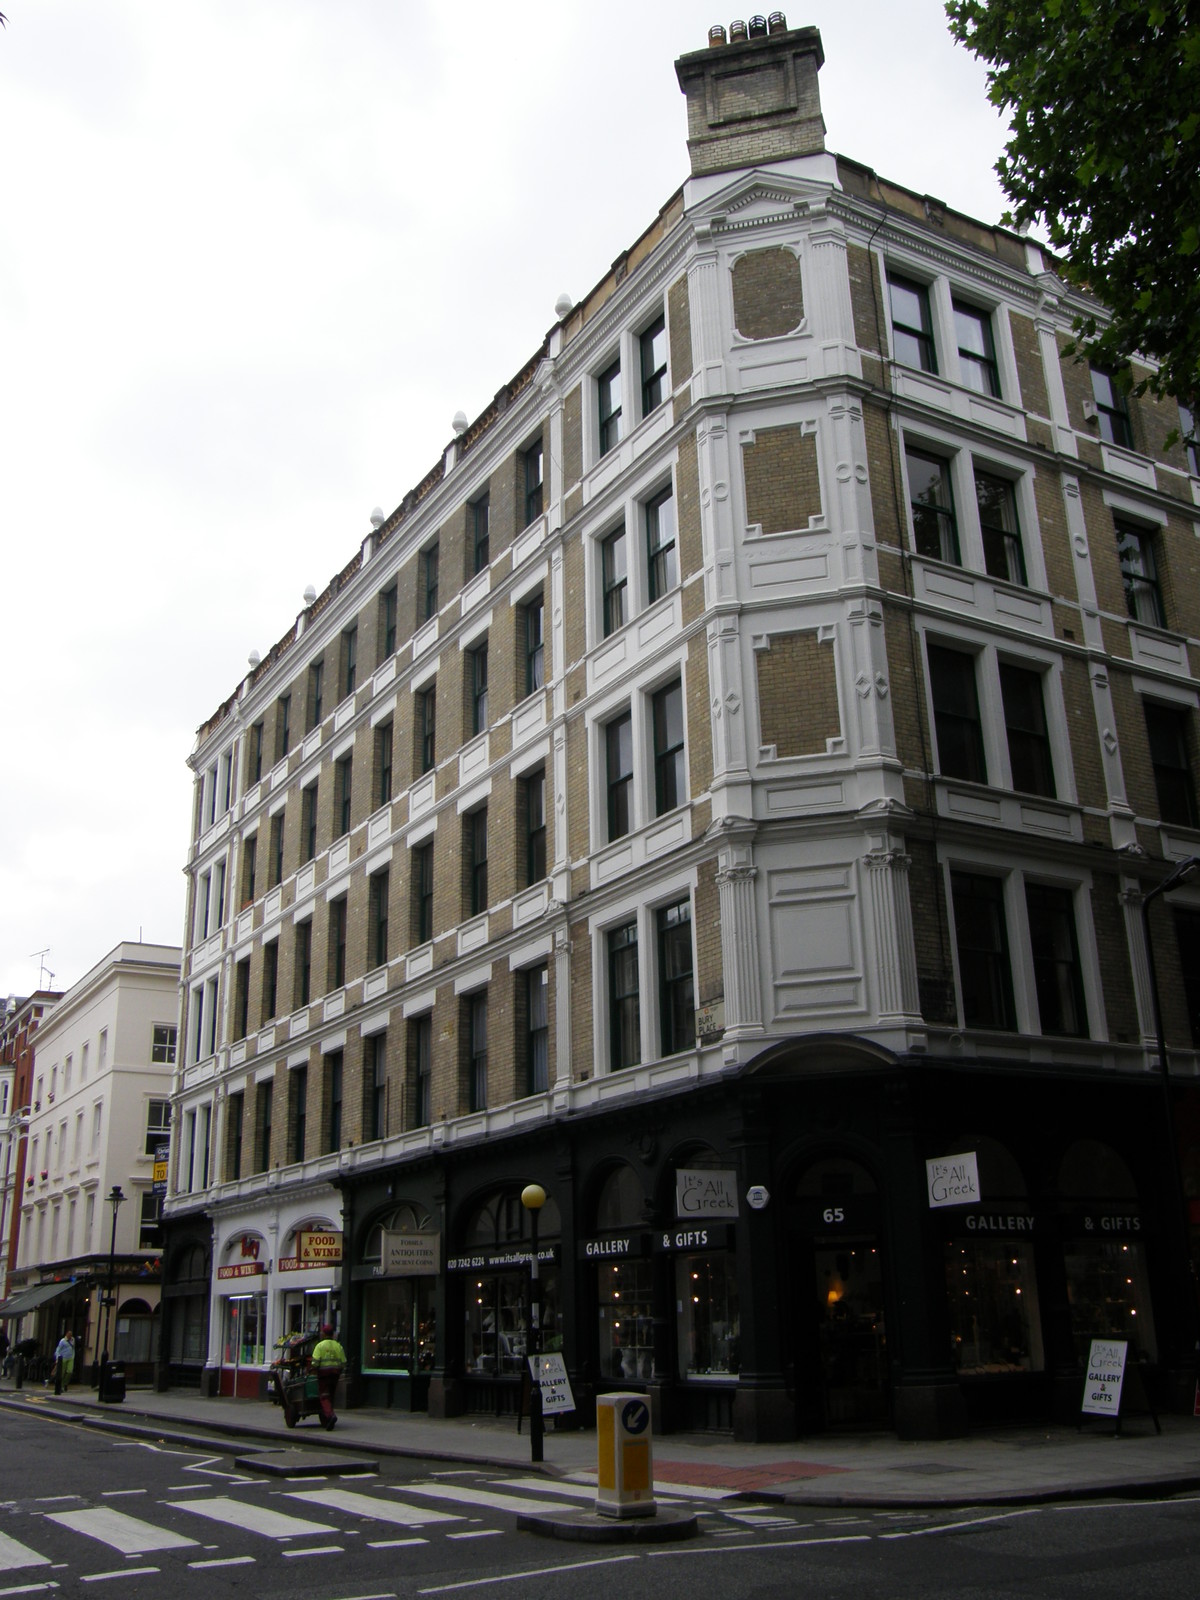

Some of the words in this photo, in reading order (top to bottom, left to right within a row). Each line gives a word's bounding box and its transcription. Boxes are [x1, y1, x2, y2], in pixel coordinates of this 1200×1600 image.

[698, 1013, 714, 1026] BURY
[698, 1022, 717, 1035] PLACE
[932, 1164, 948, 1179] It's
[950, 1165, 966, 1182] All
[683, 1175, 703, 1189] It's
[703, 1180, 723, 1196] All
[931, 1176, 976, 1202] Greek
[682, 1187, 735, 1212] Greek
[822, 1207, 845, 1223] 65
[966, 1215, 1035, 1230] GALLERY
[1084, 1216, 1094, 1230] &
[1100, 1216, 1141, 1231] GIFTS
[308, 1236, 336, 1246] FOOD
[662, 1234, 671, 1248] &
[675, 1230, 708, 1247] GIFTS
[303, 1248, 310, 1257] &
[313, 1248, 341, 1257] WINE
[586, 1239, 630, 1255] GALLERY
[280, 1259, 298, 1270] FOOD
[447, 1259, 457, 1269] 020
[458, 1258, 471, 1268] 7242
[471, 1256, 485, 1266] 6224
[488, 1248, 555, 1265] www.itsallgreeco.uk
[219, 1267, 233, 1278] FOOD
[234, 1267, 239, 1276] &
[240, 1264, 256, 1275] WINE
[1090, 1352, 1122, 1368] Greek
[1088, 1373, 1121, 1382] GALLERY
[1100, 1383, 1106, 1391] &
[545, 1394, 566, 1404] GIFTS
[1091, 1392, 1113, 1402] GIFTS
